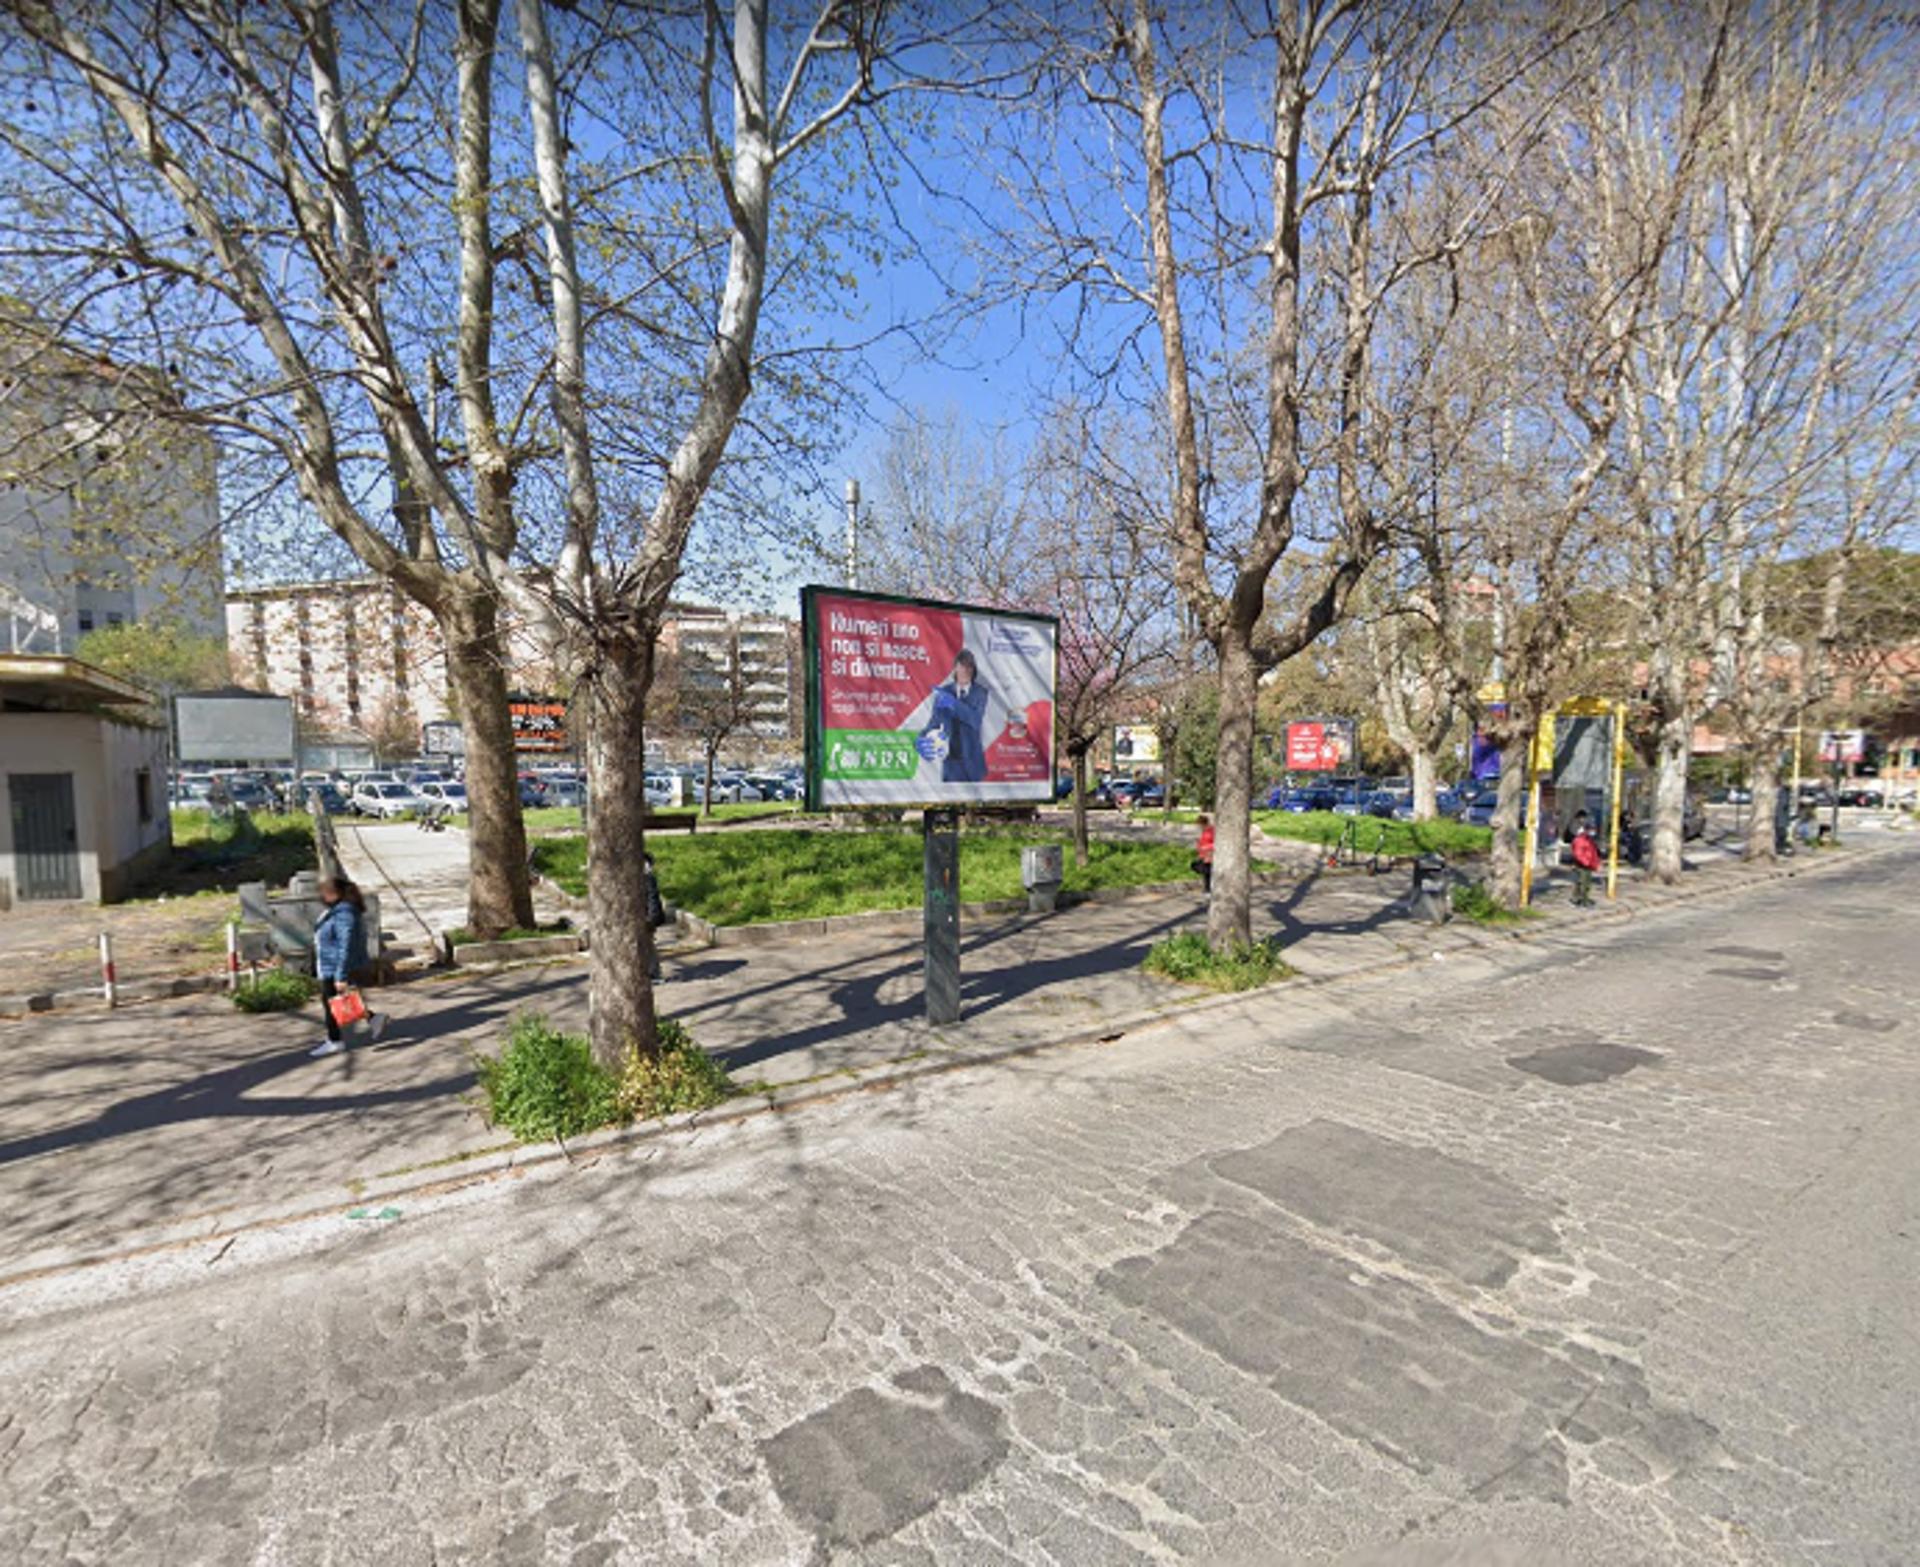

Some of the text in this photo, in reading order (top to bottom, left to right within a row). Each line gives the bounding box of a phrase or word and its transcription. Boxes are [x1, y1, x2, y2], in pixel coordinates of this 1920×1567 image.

[831, 611, 888, 636] Numeri
[831, 637, 860, 655] non
[865, 637, 880, 657] si
[831, 656, 910, 680] si diventa.
